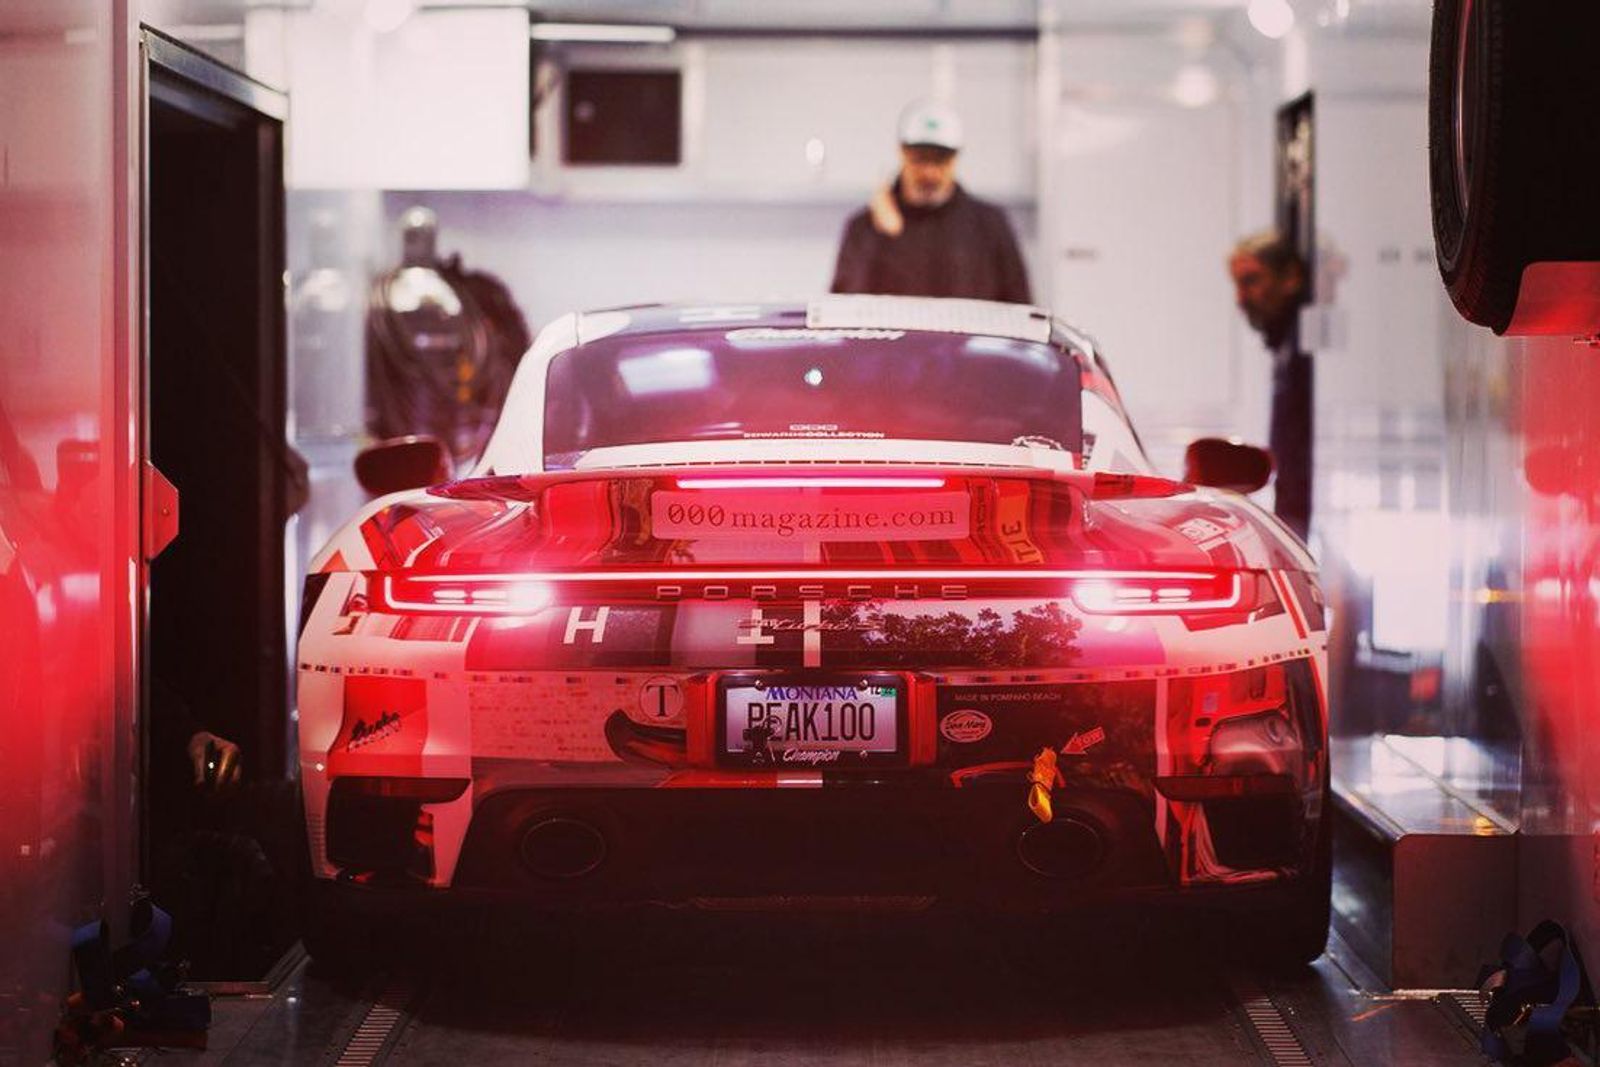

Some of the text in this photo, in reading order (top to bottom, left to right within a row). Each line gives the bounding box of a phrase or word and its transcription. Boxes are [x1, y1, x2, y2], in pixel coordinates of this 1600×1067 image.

[656, 585, 968, 600] PORSCHE
[646, 685, 678, 717] T
[766, 686, 858, 701] MONTANA
[954, 692, 1062, 701] MADE IN POMPANO BEACH
[747, 702, 875, 742] PEAK100
[782, 747, 840, 766] Champion
